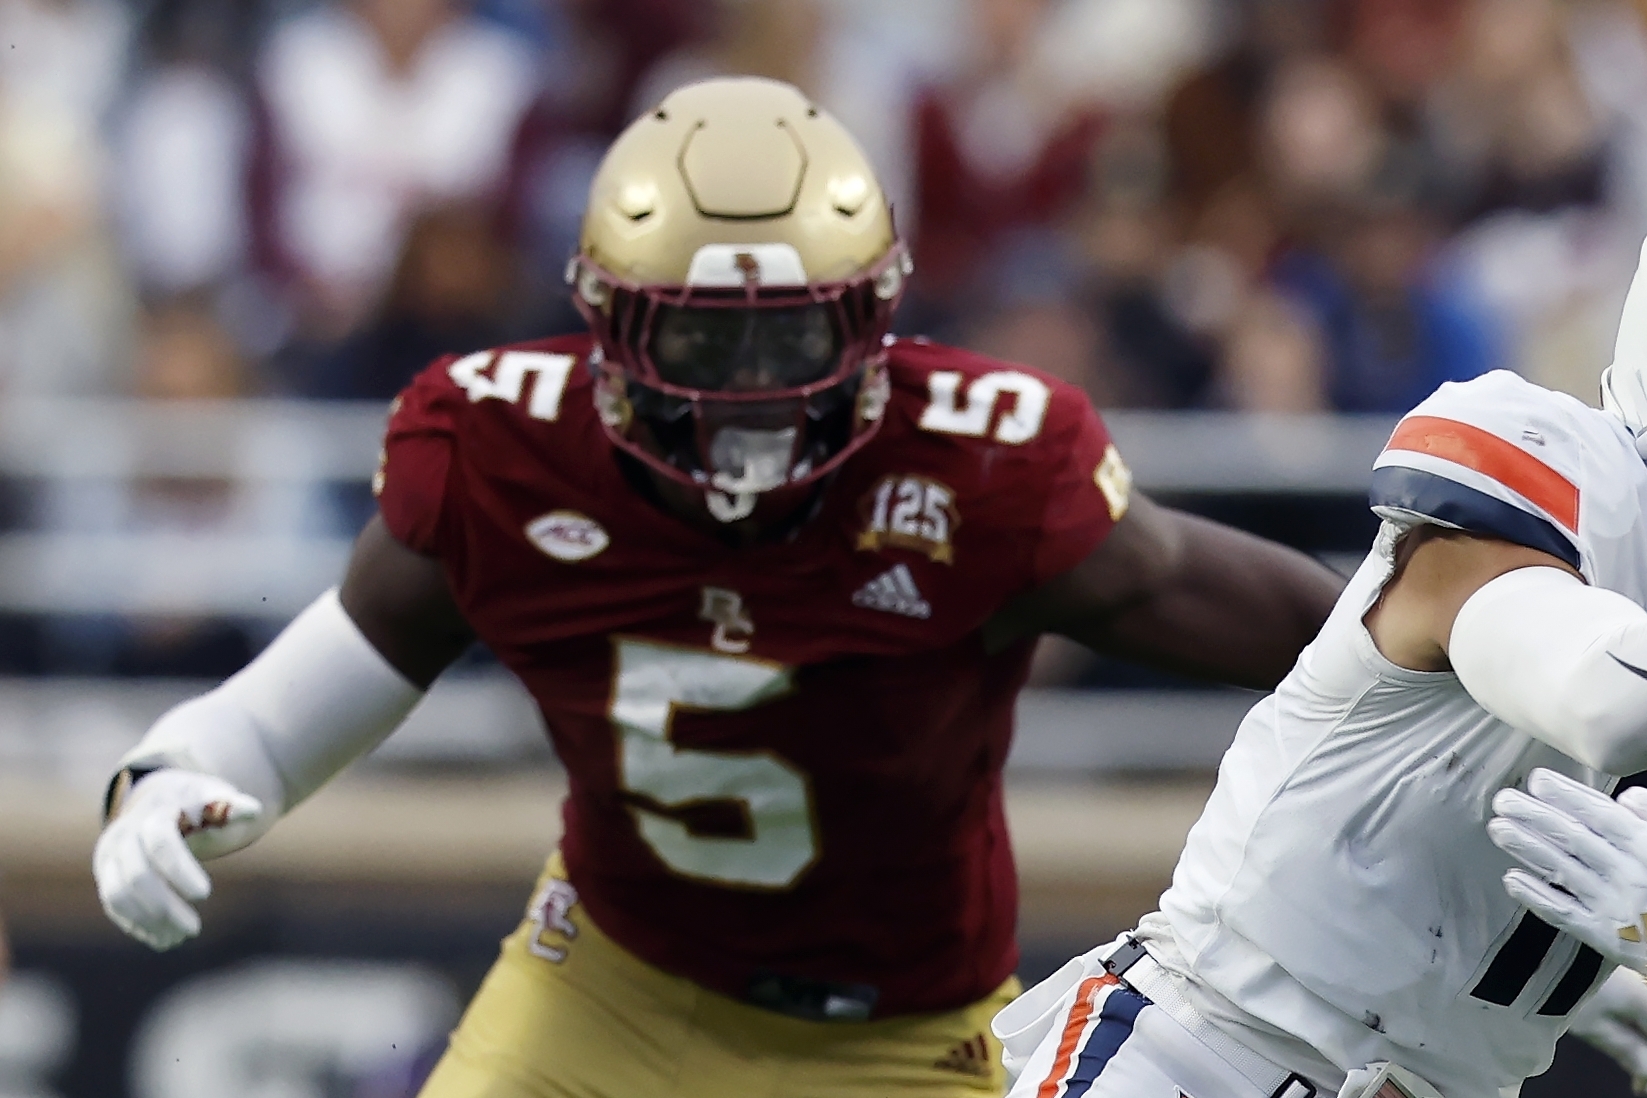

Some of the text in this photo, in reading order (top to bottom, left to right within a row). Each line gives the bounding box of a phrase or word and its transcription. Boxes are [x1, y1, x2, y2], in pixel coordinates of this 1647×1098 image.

[447, 350, 576, 422] 5
[917, 369, 1053, 446] 5
[872, 478, 950, 543] 125
[604, 631, 823, 893] 5
